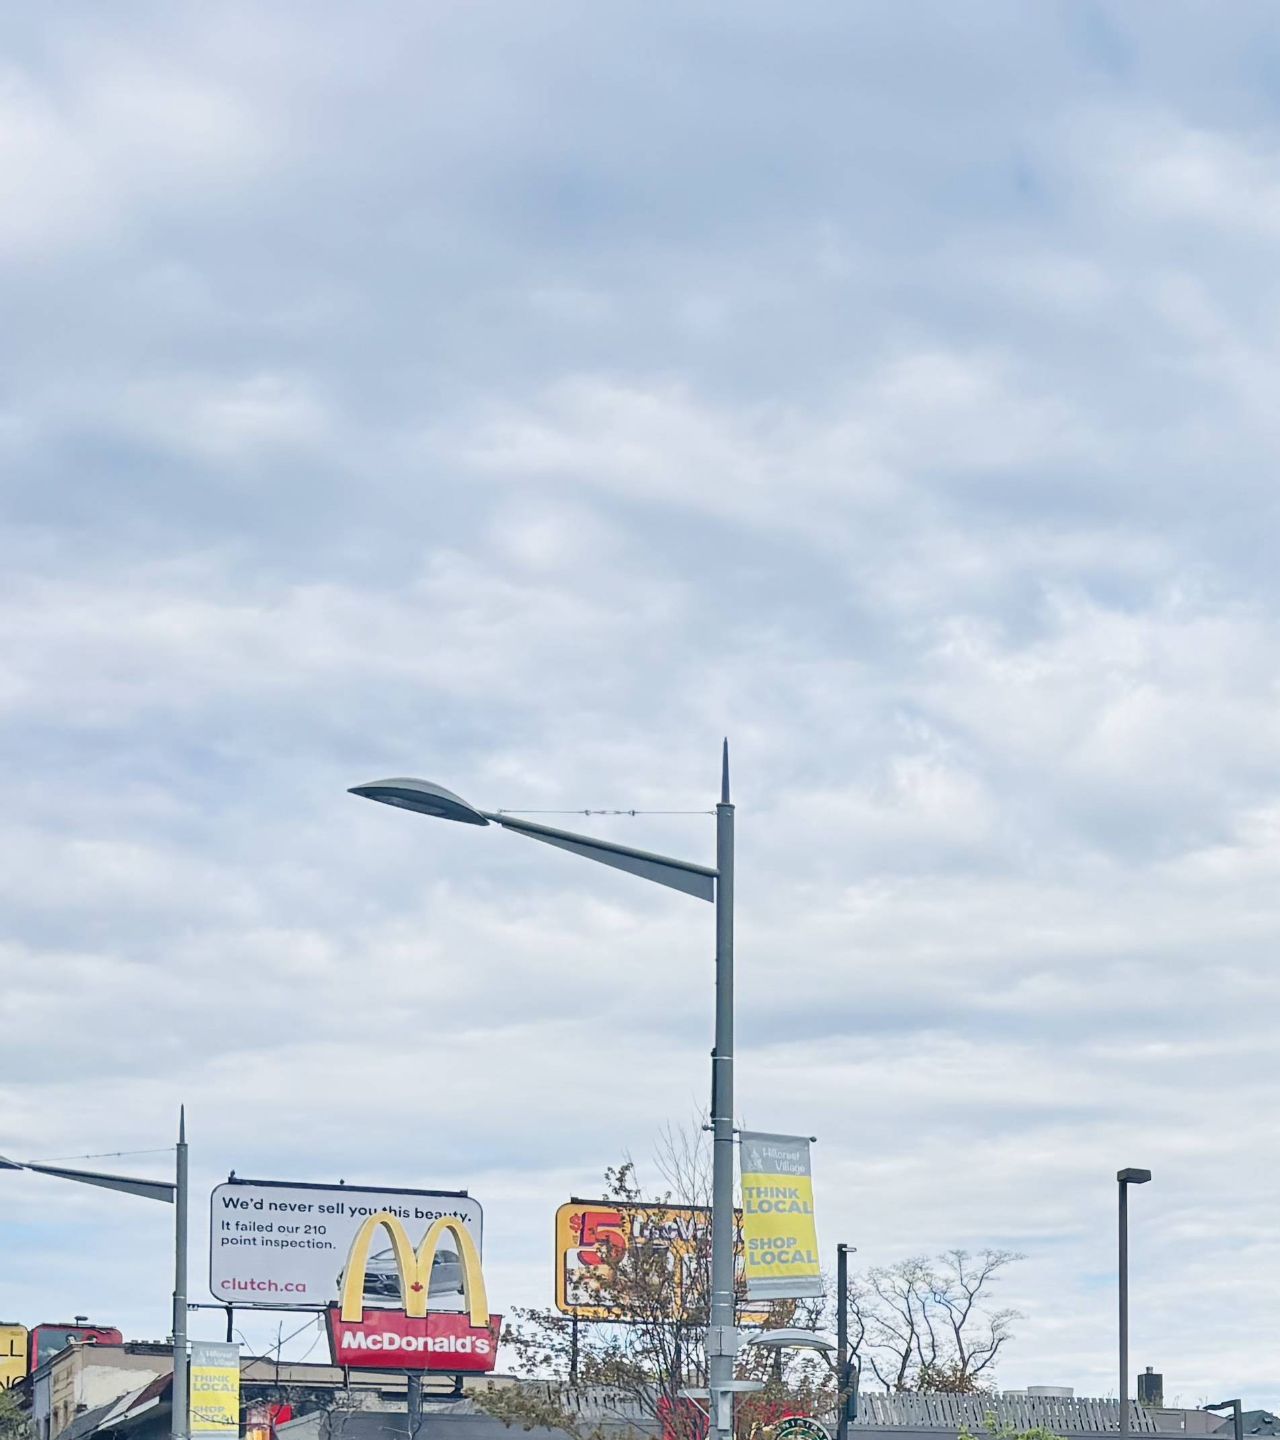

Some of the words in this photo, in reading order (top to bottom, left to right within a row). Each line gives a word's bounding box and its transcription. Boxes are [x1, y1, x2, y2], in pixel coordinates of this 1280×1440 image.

[775, 1160, 806, 1175] Village
[744, 1186, 800, 1200] THINK
[222, 1196, 263, 1211] We'd
[269, 1202, 314, 1214] never
[318, 1202, 345, 1214] sell
[349, 1206, 377, 1217] you
[746, 1200, 814, 1214] LOCAL
[221, 1220, 232, 1231] It
[235, 1221, 273, 1233] failed
[278, 1225, 300, 1235] our
[304, 1224, 327, 1235] 210
[221, 1235, 257, 1249] point
[261, 1236, 336, 1250] inspection.
[748, 1237, 797, 1250] SHOP
[749, 1250, 818, 1266] LOCAL
[221, 1278, 307, 1293] clutch.ca
[341, 1330, 490, 1354] McDonald's
[192, 1375, 230, 1383] THINK
[193, 1383, 237, 1392] LOCAL
